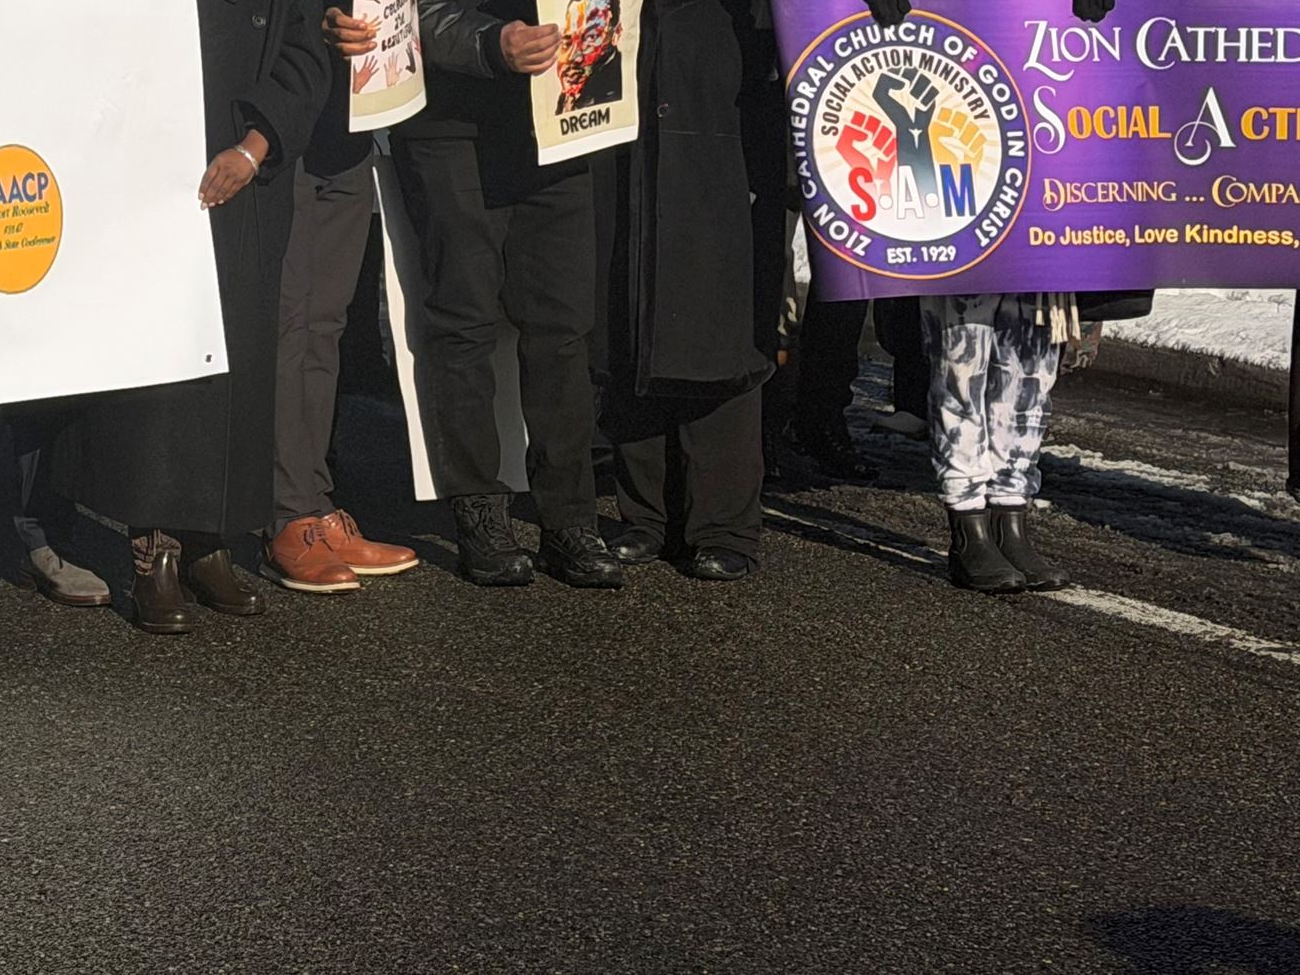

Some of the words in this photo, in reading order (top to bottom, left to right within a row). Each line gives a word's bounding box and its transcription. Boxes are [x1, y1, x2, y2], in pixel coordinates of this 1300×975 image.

[834, 21, 935, 58] CHURCH
[943, 35, 978, 63] OF
[1023, 20, 1122, 82] ZION
[821, 77, 856, 137] SOCIAL
[851, 48, 914, 81] ACTION
[918, 52, 991, 122] MINISTRY
[978, 64, 1019, 121] GOD
[560, 107, 611, 136] DREAM
[790, 56, 834, 199] CATHEDRAL
[1033, 85, 1172, 155] SOCIAL
[1007, 130, 1025, 157] IN
[974, 167, 1023, 248] CHRIST
[1043, 178, 1177, 212] DISCERNING
[813, 203, 875, 256] ZION
[1029, 227, 1056, 246] Do
[1060, 225, 1130, 247] Justice,
[1135, 225, 1179, 244] Love
[1185, 225, 1300, 248] Kindness,
[886, 247, 917, 264] EST.
[921, 246, 956, 263] 1929
